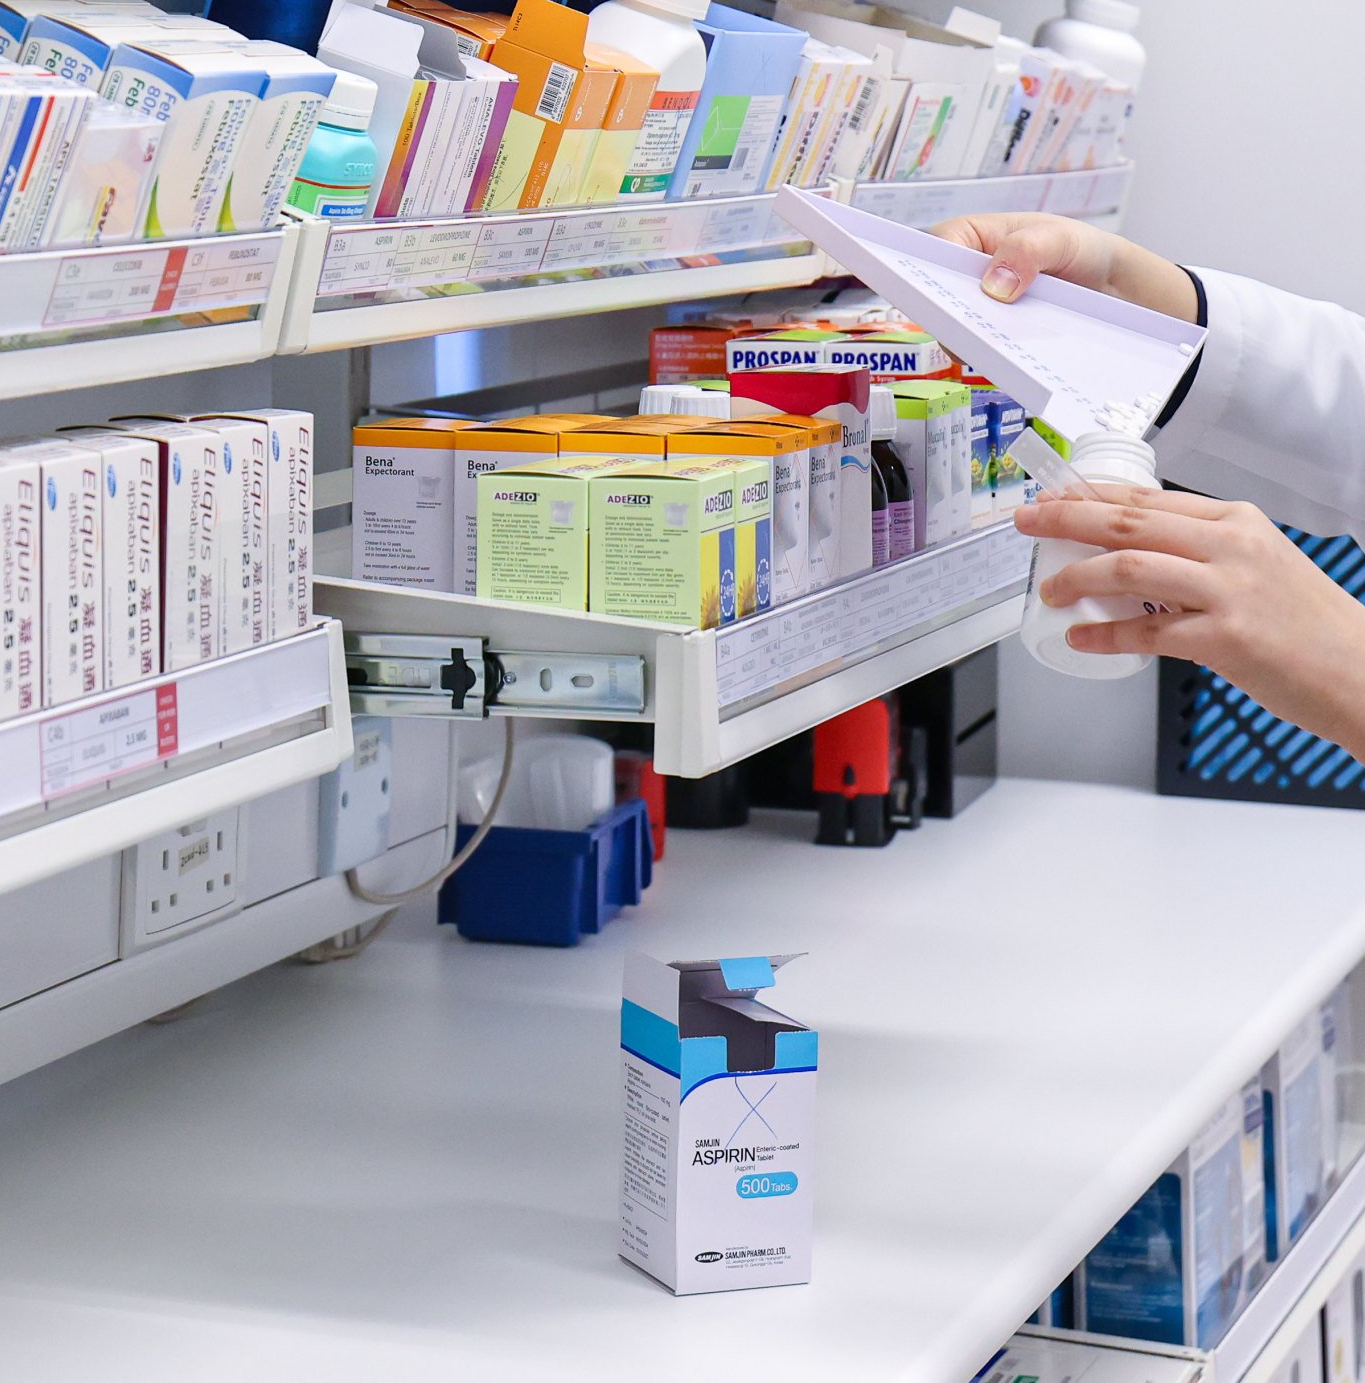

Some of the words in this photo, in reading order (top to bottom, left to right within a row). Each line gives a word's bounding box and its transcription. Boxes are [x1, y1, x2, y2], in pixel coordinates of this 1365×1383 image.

[476, 97, 494, 148] ANALEVO
[189, 99, 235, 201] Febuxostat
[261, 100, 307, 196] Febuxostat
[402, 134, 410, 146] 100
[467, 148, 480, 178] Tablets
[374, 235, 393, 246] ASPIRIN
[484, 229, 495, 241] B3c
[517, 226, 533, 237] ASPIRIN
[333, 239, 346, 252] B3a
[733, 350, 817, 368] PROSPAN
[831, 352, 916, 372] PROSPAN
[842, 425, 866, 449] Bronal
[365, 456, 393, 467] Bena
[365, 467, 414, 477] Expectorant
[467, 460, 495, 471] Bena
[775, 465, 790, 481] Bena
[811, 456, 826, 473] Bena
[297, 426, 309, 535] Eliquis
[775, 477, 802, 496] Expectorant
[811, 470, 836, 486] Expectorant
[250, 437, 264, 549] Eliquis
[287, 446, 295, 535] apixaban
[494, 491, 537, 502] ADEZIO
[607, 494, 650, 504] ADEZIO
[704, 490, 732, 515] ADEZIO
[741, 480, 768, 505] ADEZIO
[200, 447, 216, 561] Eliquis
[234, 458, 249, 548] apixaban
[136, 457, 153, 575] Eliquis
[188, 468, 199, 568] apixaban
[80, 468, 97, 589] Eliquis
[14, 479, 33, 604] Eliquis
[68, 492, 77, 591] apixaban
[2, 503, 12, 605] apixaban
[241, 552, 250, 589] 2.5
[187, 564, 196, 603] 2.5
[127, 578, 136, 617] 2.5
[68, 594, 78, 634] 2.5
[2, 609, 14, 649] 2.5
[695, 1138, 720, 1148] SAMJIN
[756, 1142, 800, 1152] Enteric-coated
[692, 1147, 755, 1166] ASPIRIN
[741, 1178, 770, 1195] 500
[771, 1182, 792, 1192] Tabs.
[697, 1253, 722, 1262] SAMJIN
[725, 1249, 746, 1259] SAMJIN
